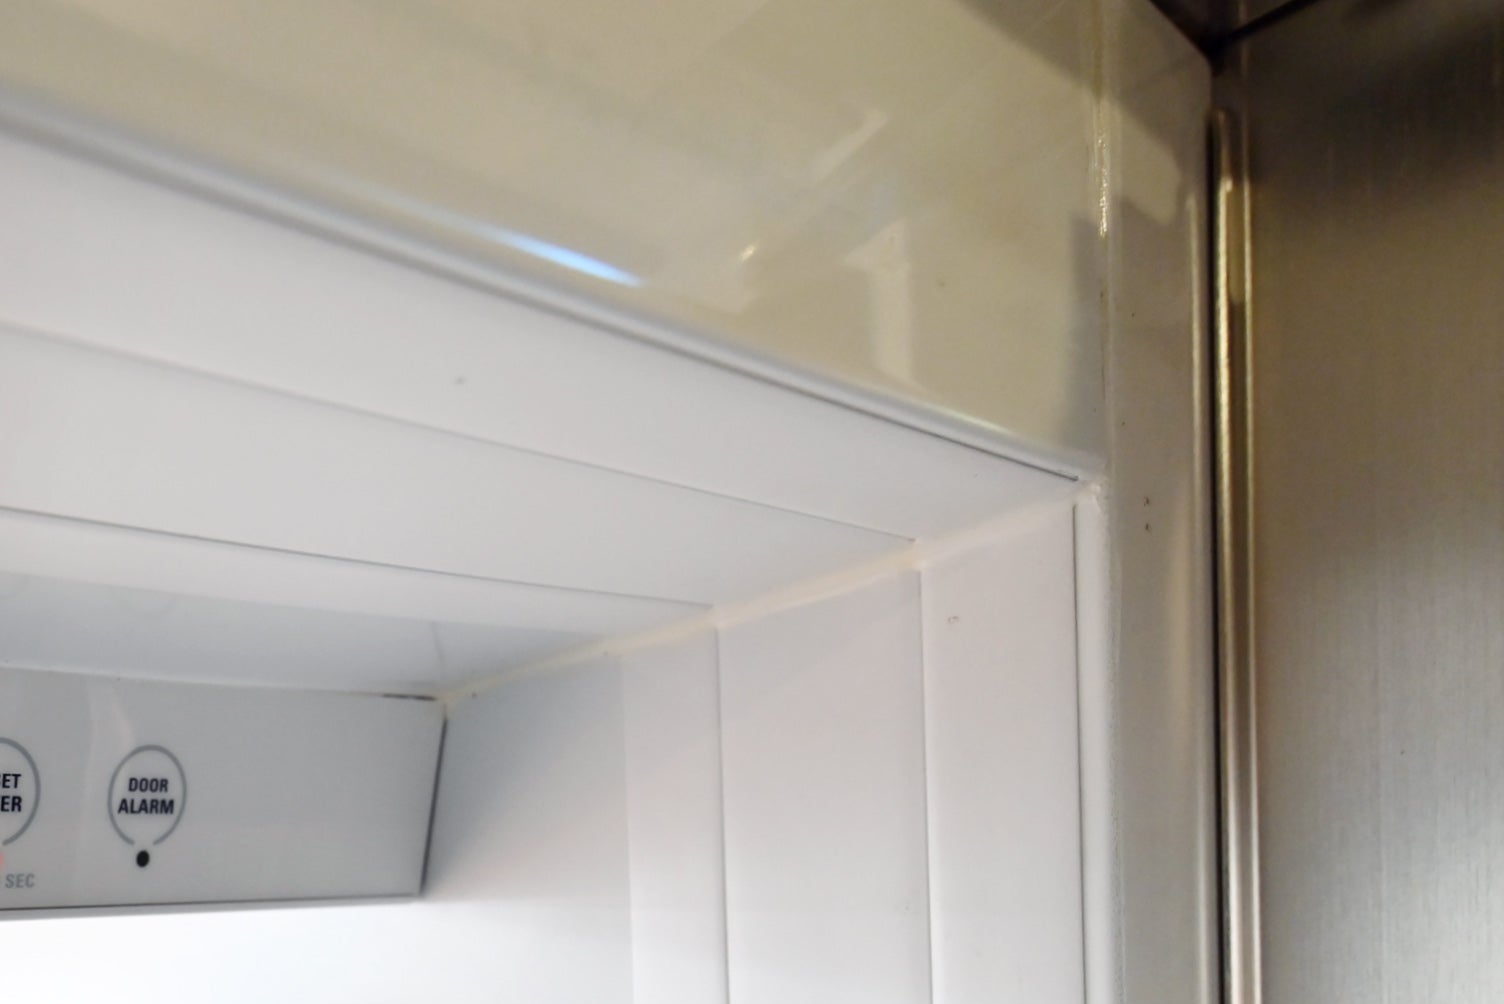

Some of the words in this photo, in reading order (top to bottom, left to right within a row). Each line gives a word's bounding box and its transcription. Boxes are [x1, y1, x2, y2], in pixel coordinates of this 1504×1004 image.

[129, 778, 169, 793] DOOR
[118, 797, 175, 814] ALARM
[5, 873, 35, 888] SEC
